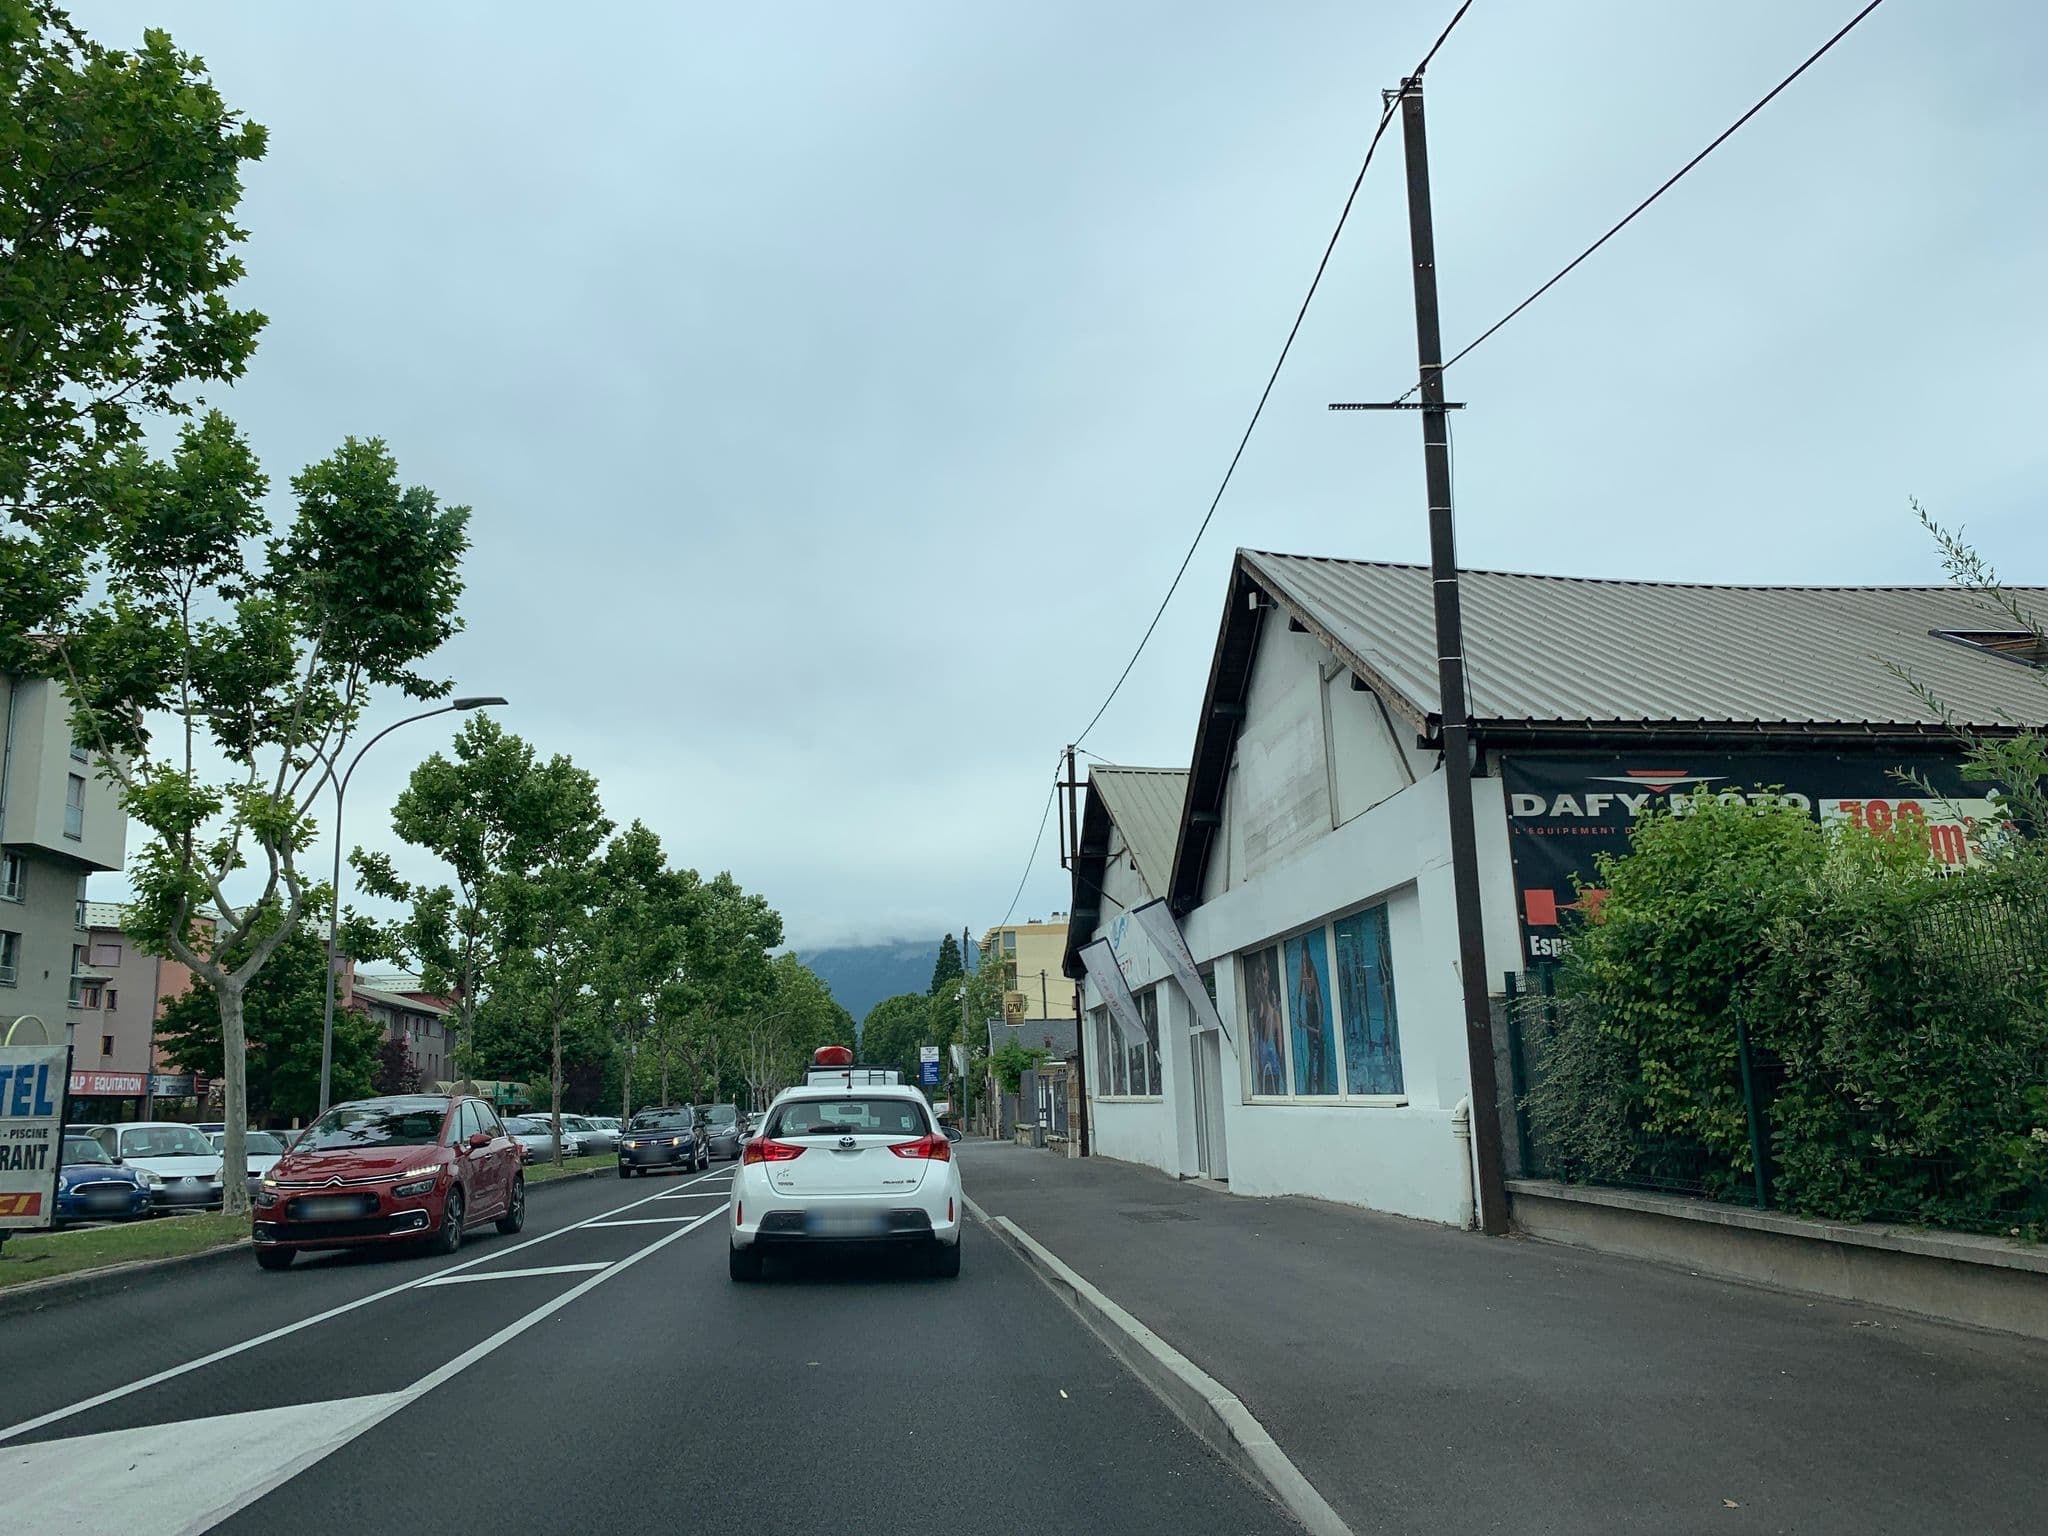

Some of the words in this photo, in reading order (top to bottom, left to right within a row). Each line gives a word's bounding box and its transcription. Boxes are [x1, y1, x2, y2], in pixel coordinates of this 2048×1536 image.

[1510, 793, 1650, 817] DAFY
[1515, 826, 1616, 835] L'EQUIPEMENT
[9, 1128, 49, 1139] PISCINE
[0, 1144, 49, 1171] RANT
